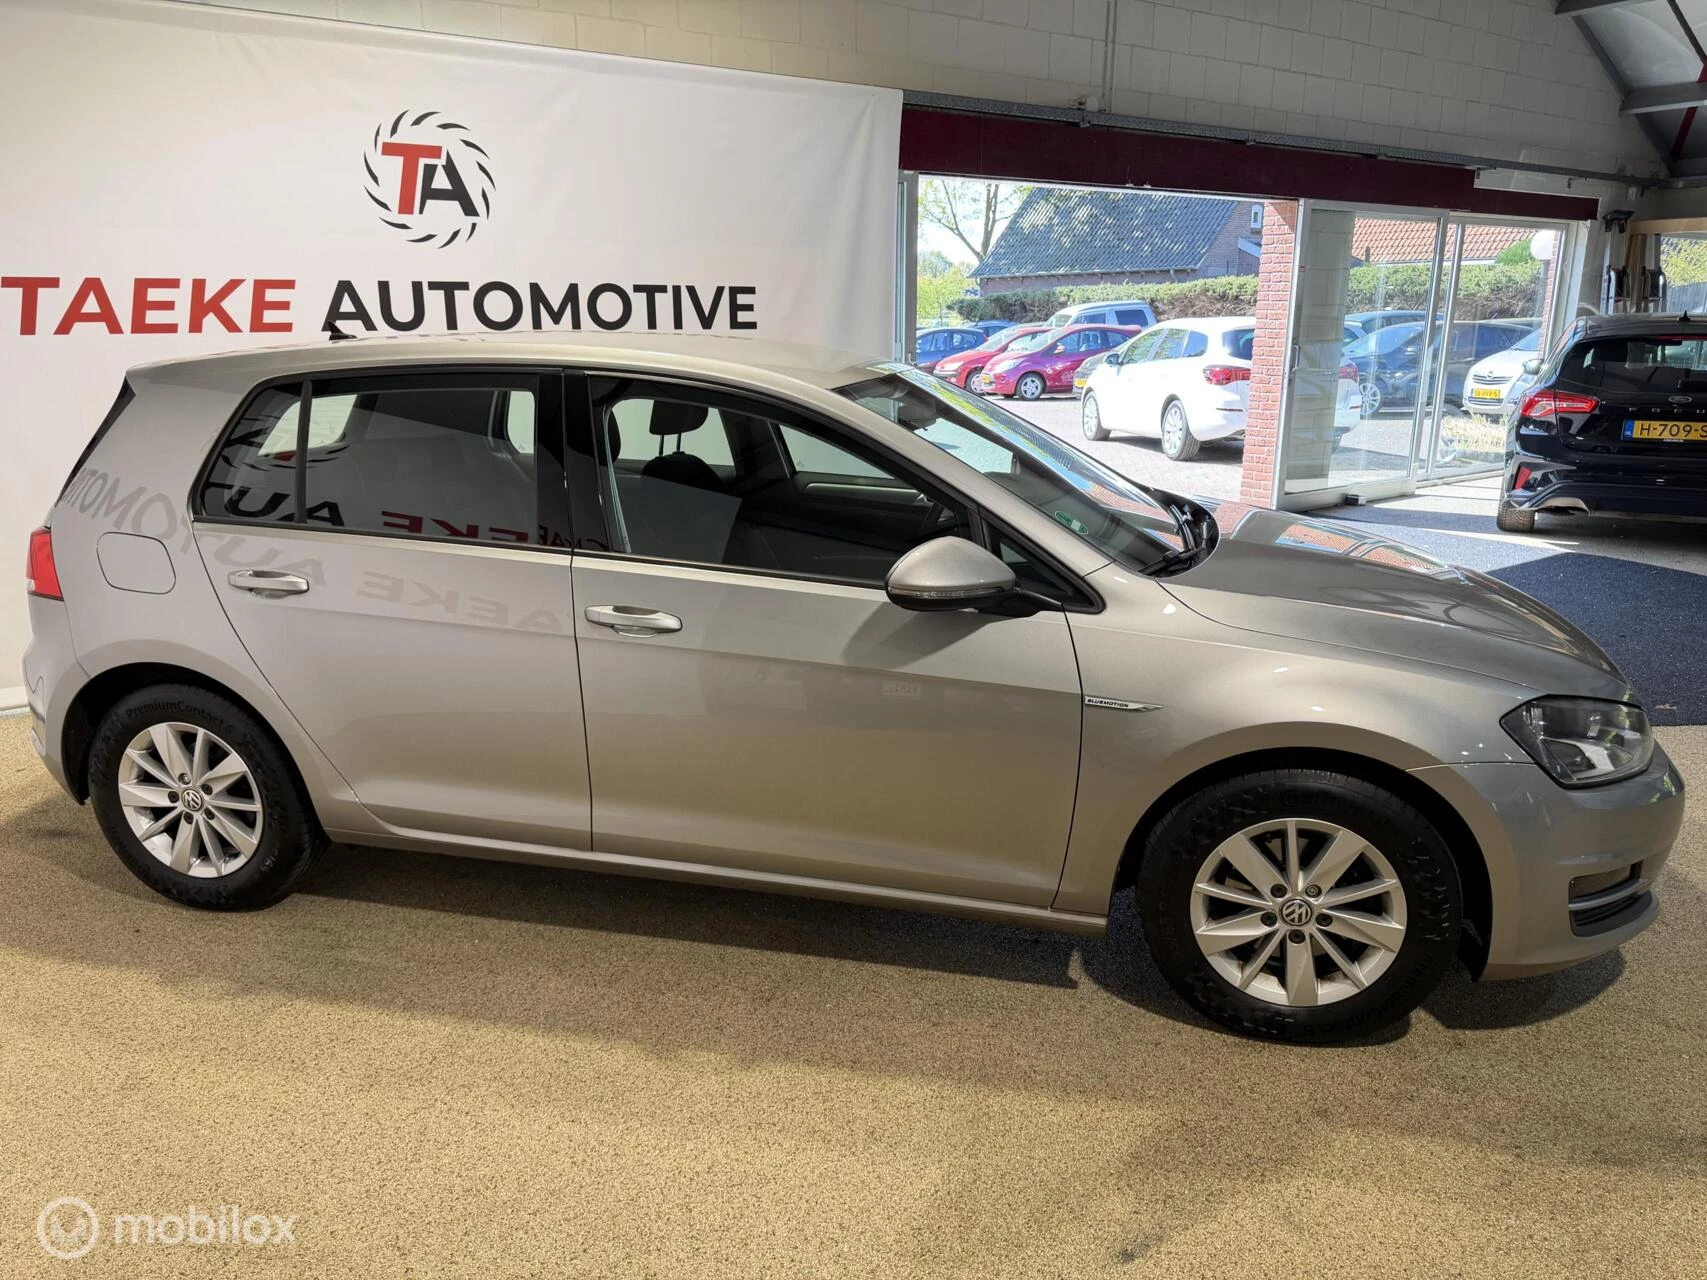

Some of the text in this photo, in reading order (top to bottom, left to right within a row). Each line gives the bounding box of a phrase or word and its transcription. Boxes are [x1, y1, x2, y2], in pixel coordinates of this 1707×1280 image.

[380, 142, 479, 217] TA
[0, 276, 757, 336] TAEKE AUTOMOTIVE
[1639, 423, 1707, 438] H-709-S
[126, 700, 224, 727] PremiumContact
[1087, 699, 1129, 708] BLUEMOTION
